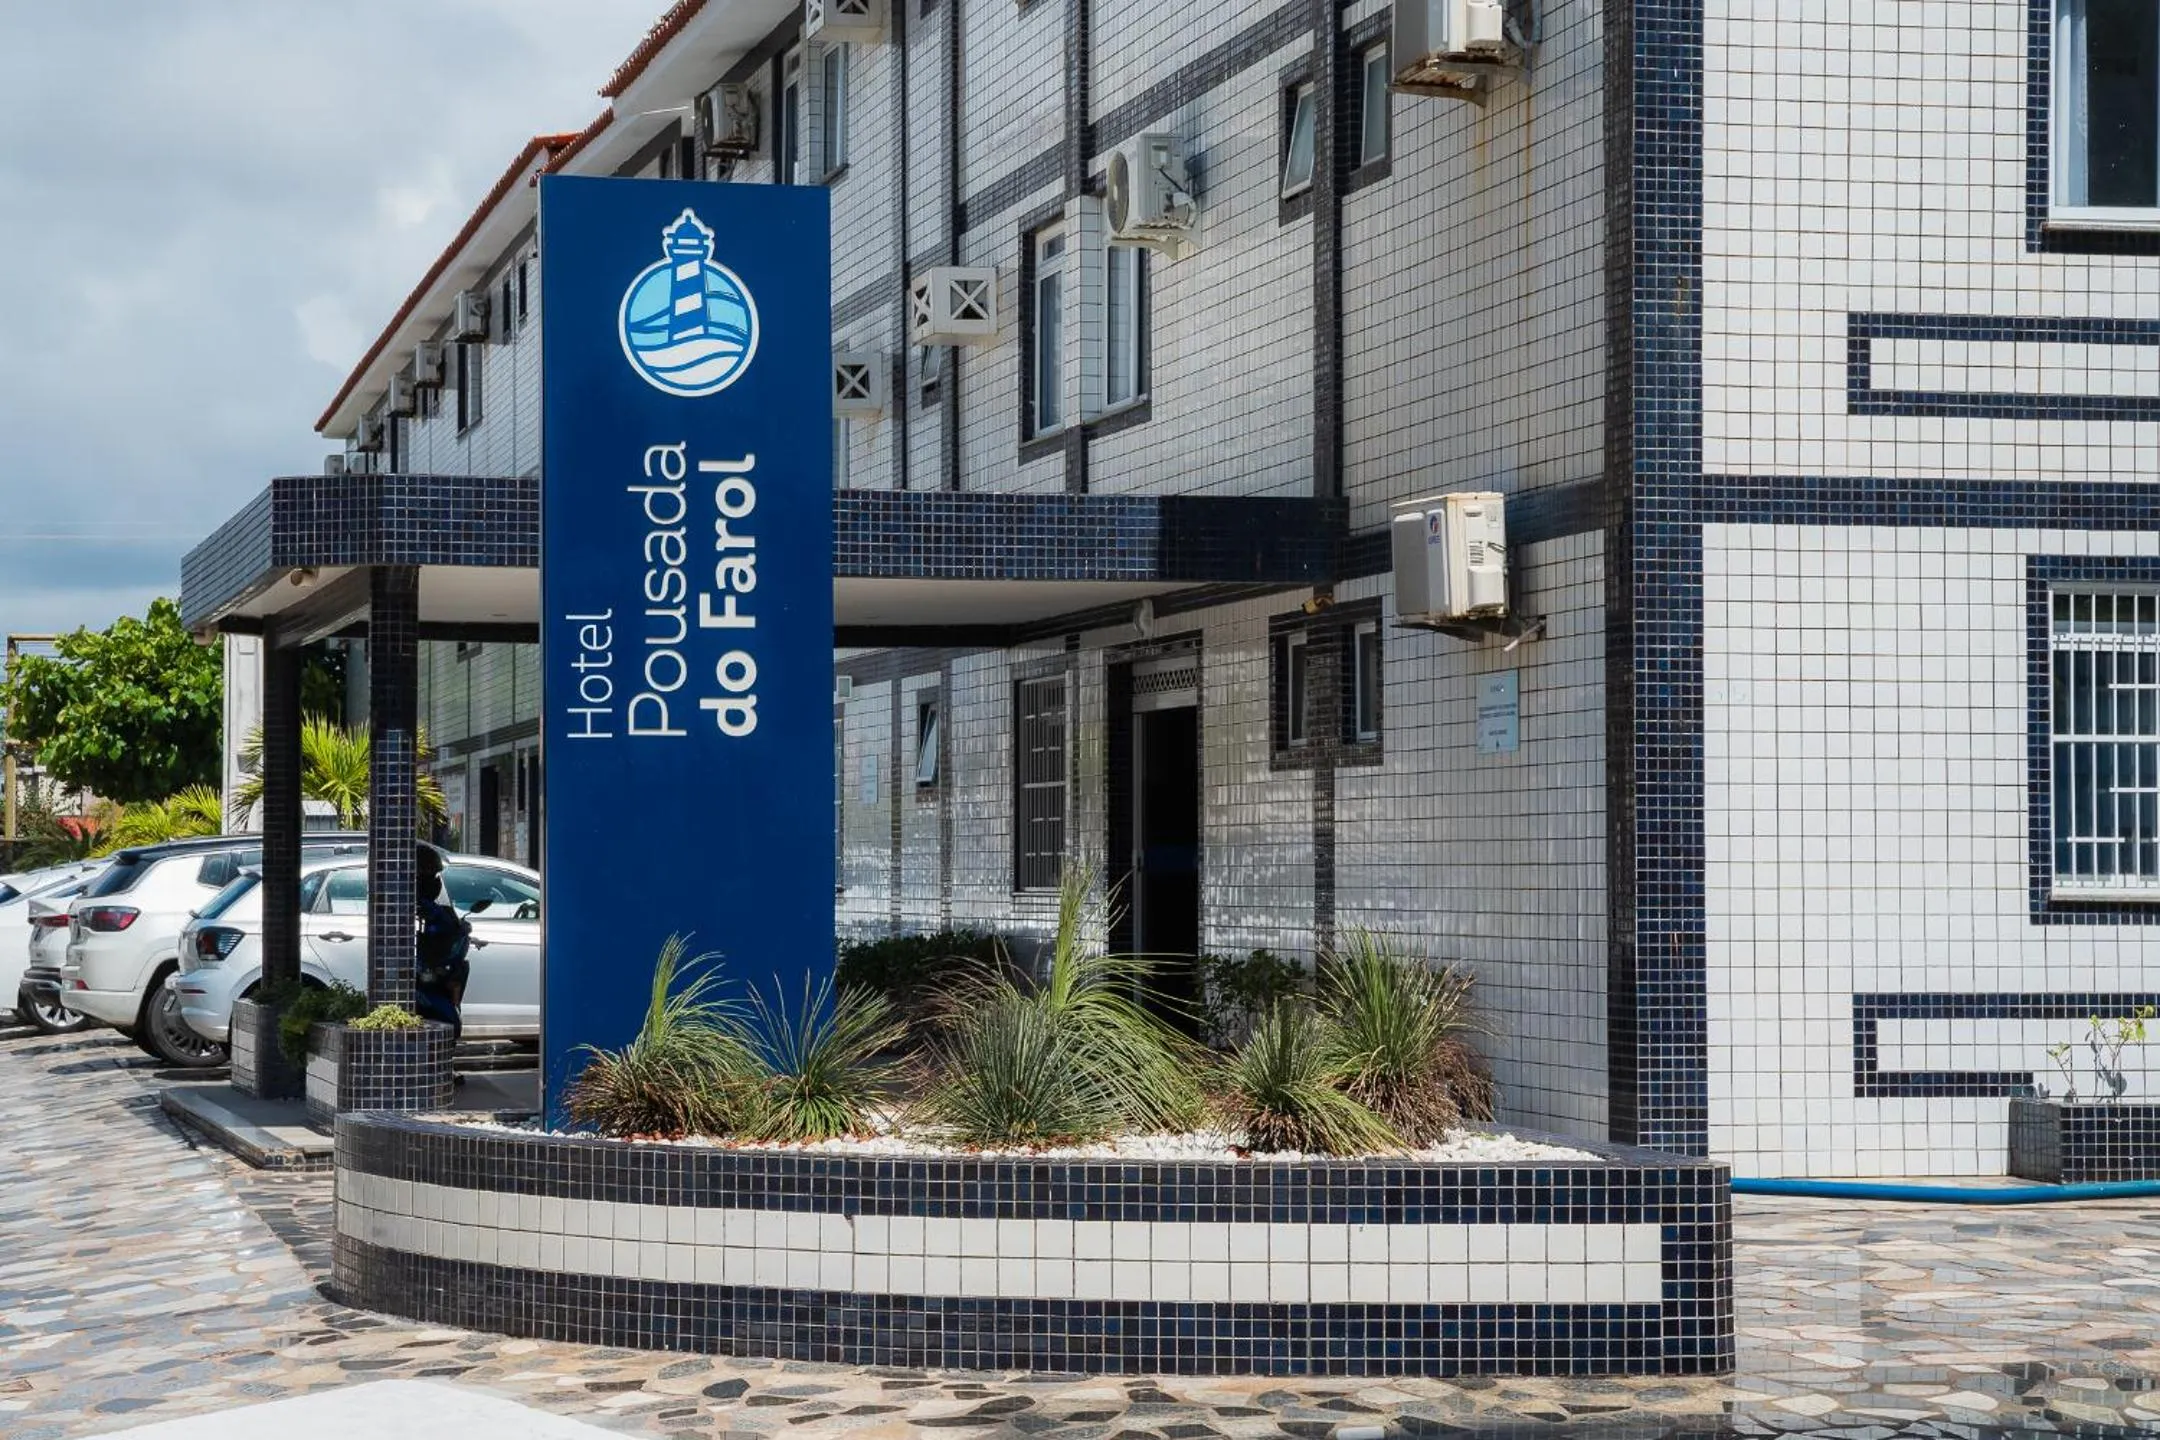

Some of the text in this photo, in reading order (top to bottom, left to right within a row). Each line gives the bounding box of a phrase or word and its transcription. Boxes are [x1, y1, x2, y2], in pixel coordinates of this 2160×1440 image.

[566, 608, 613, 738] Hotel
[627, 441, 688, 736] Pousada
[698, 453, 758, 737] do Farol
